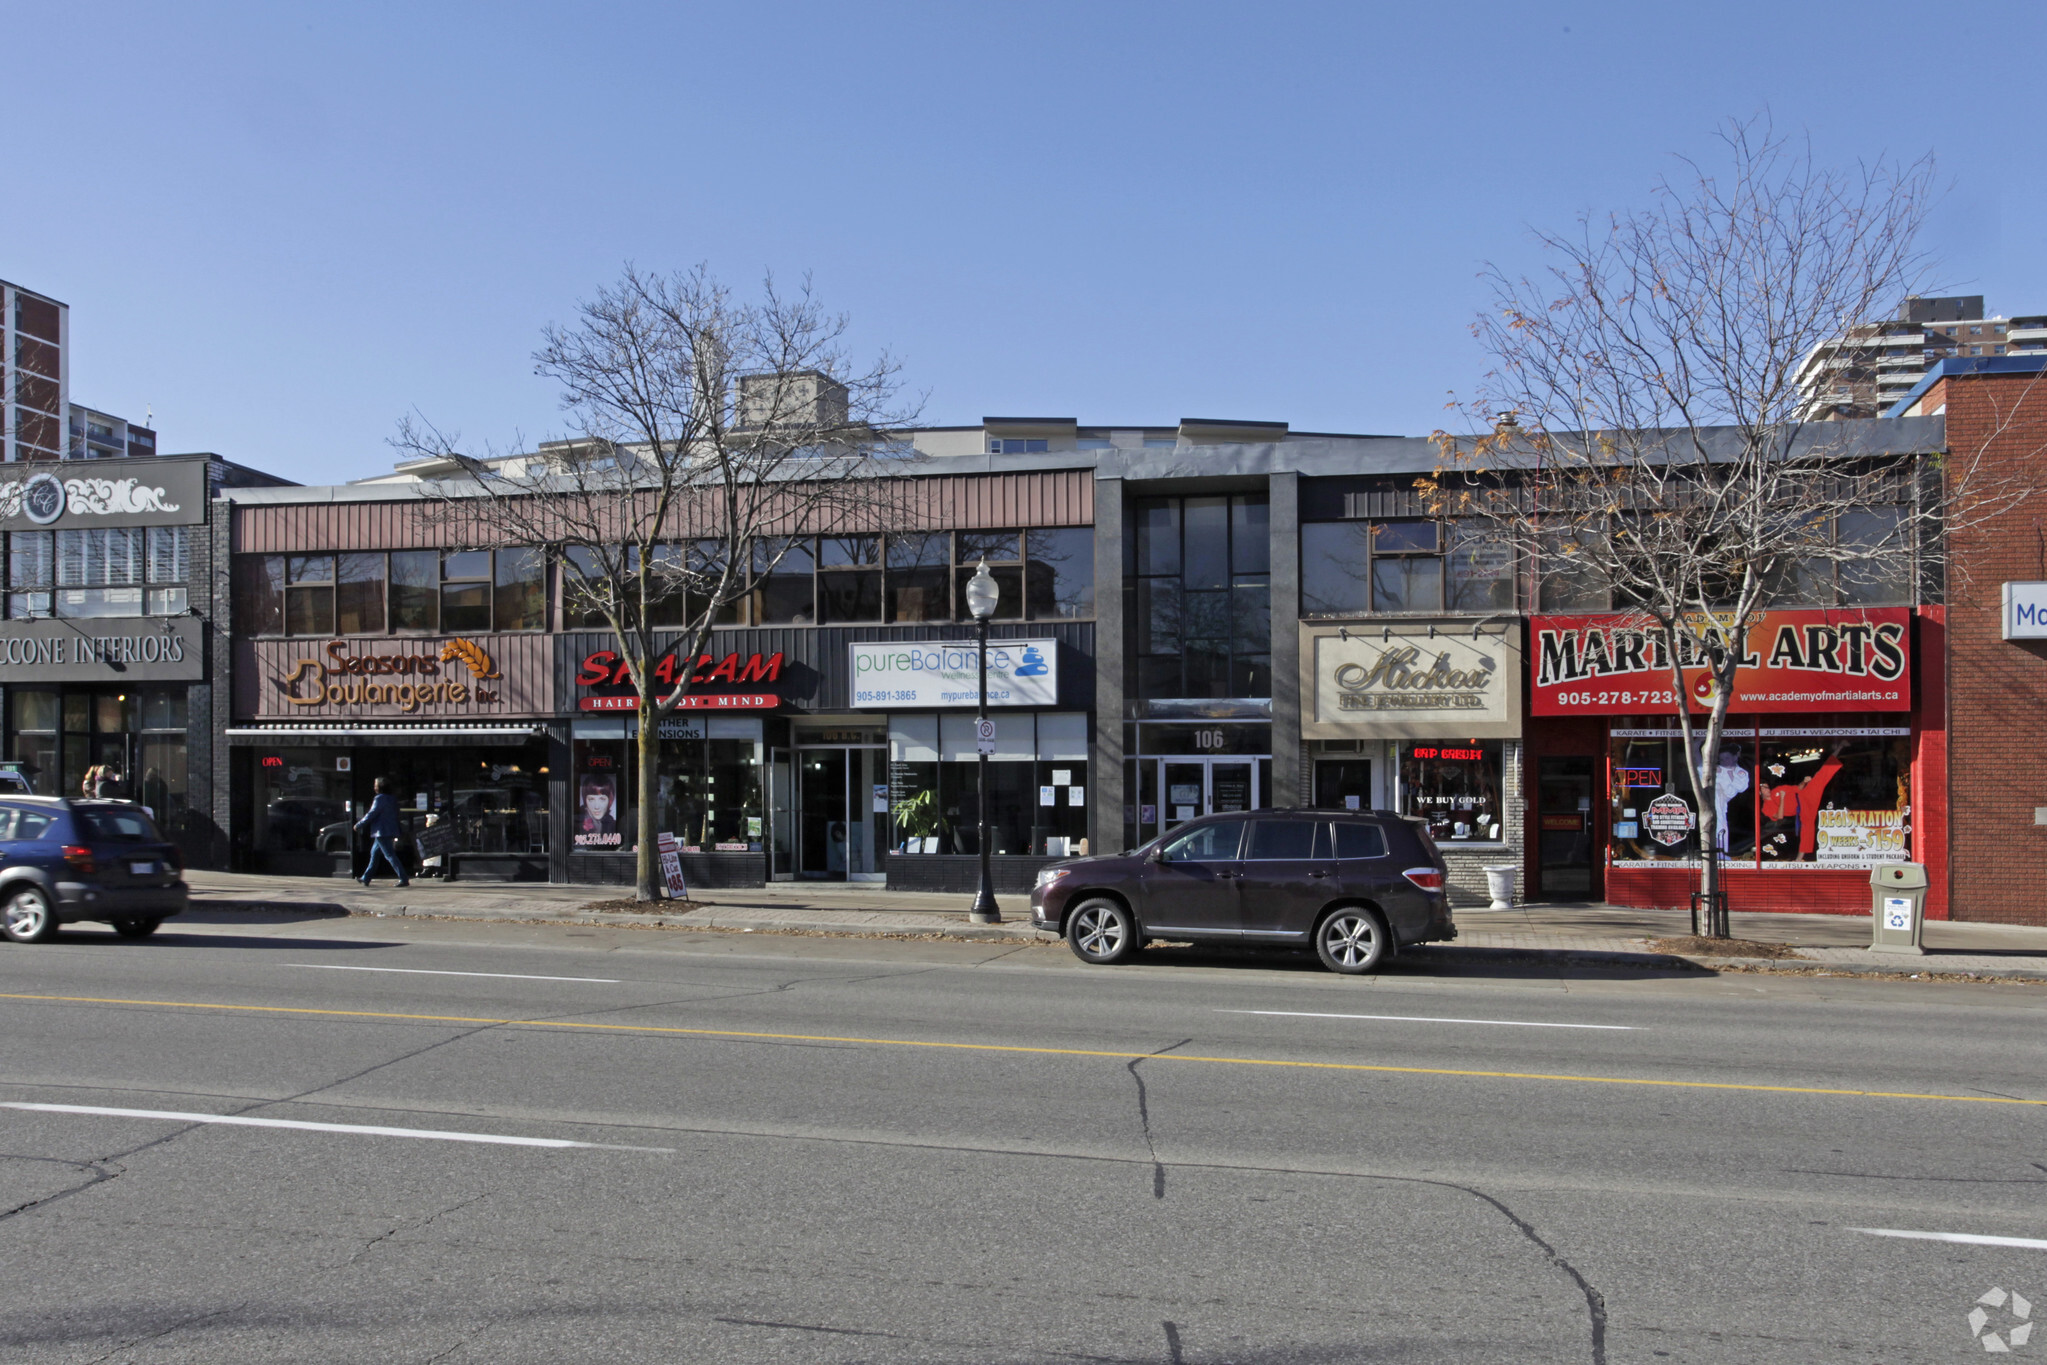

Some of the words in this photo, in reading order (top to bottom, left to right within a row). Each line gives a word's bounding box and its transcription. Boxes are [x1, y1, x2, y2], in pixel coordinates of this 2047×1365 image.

[73, 636, 184, 663] INTERIORS
[1767, 622, 1905, 681] ARTS
[326, 641, 436, 674] Seasons
[987, 669, 1010, 680] entre
[286, 659, 466, 711] Boulangerie
[593, 699, 634, 708] HAIR
[718, 697, 765, 706] MIND
[856, 690, 917, 701] 905-891-3865
[941, 689, 1010, 702] mypurebance.ca
[1557, 691, 1679, 705] 905-278-723
[1740, 690, 1899, 702] www.academyofmartialarts.ca
[632, 729, 700, 739] ENSIONS
[1194, 730, 1224, 748] 106
[1810, 728, 1858, 736] WEAPONS
[262, 756, 283, 767] OPEN
[1614, 769, 1662, 786] OPEN
[1416, 796, 1433, 804] WE
[1436, 796, 1457, 804] BUY
[1458, 796, 1486, 804] GOLD
[1544, 818, 1580, 826] WELCOME
[1819, 810, 1903, 828] REGISTRATION
[1818, 830, 1829, 849] 9
[1812, 862, 1860, 870] WEAPONS
